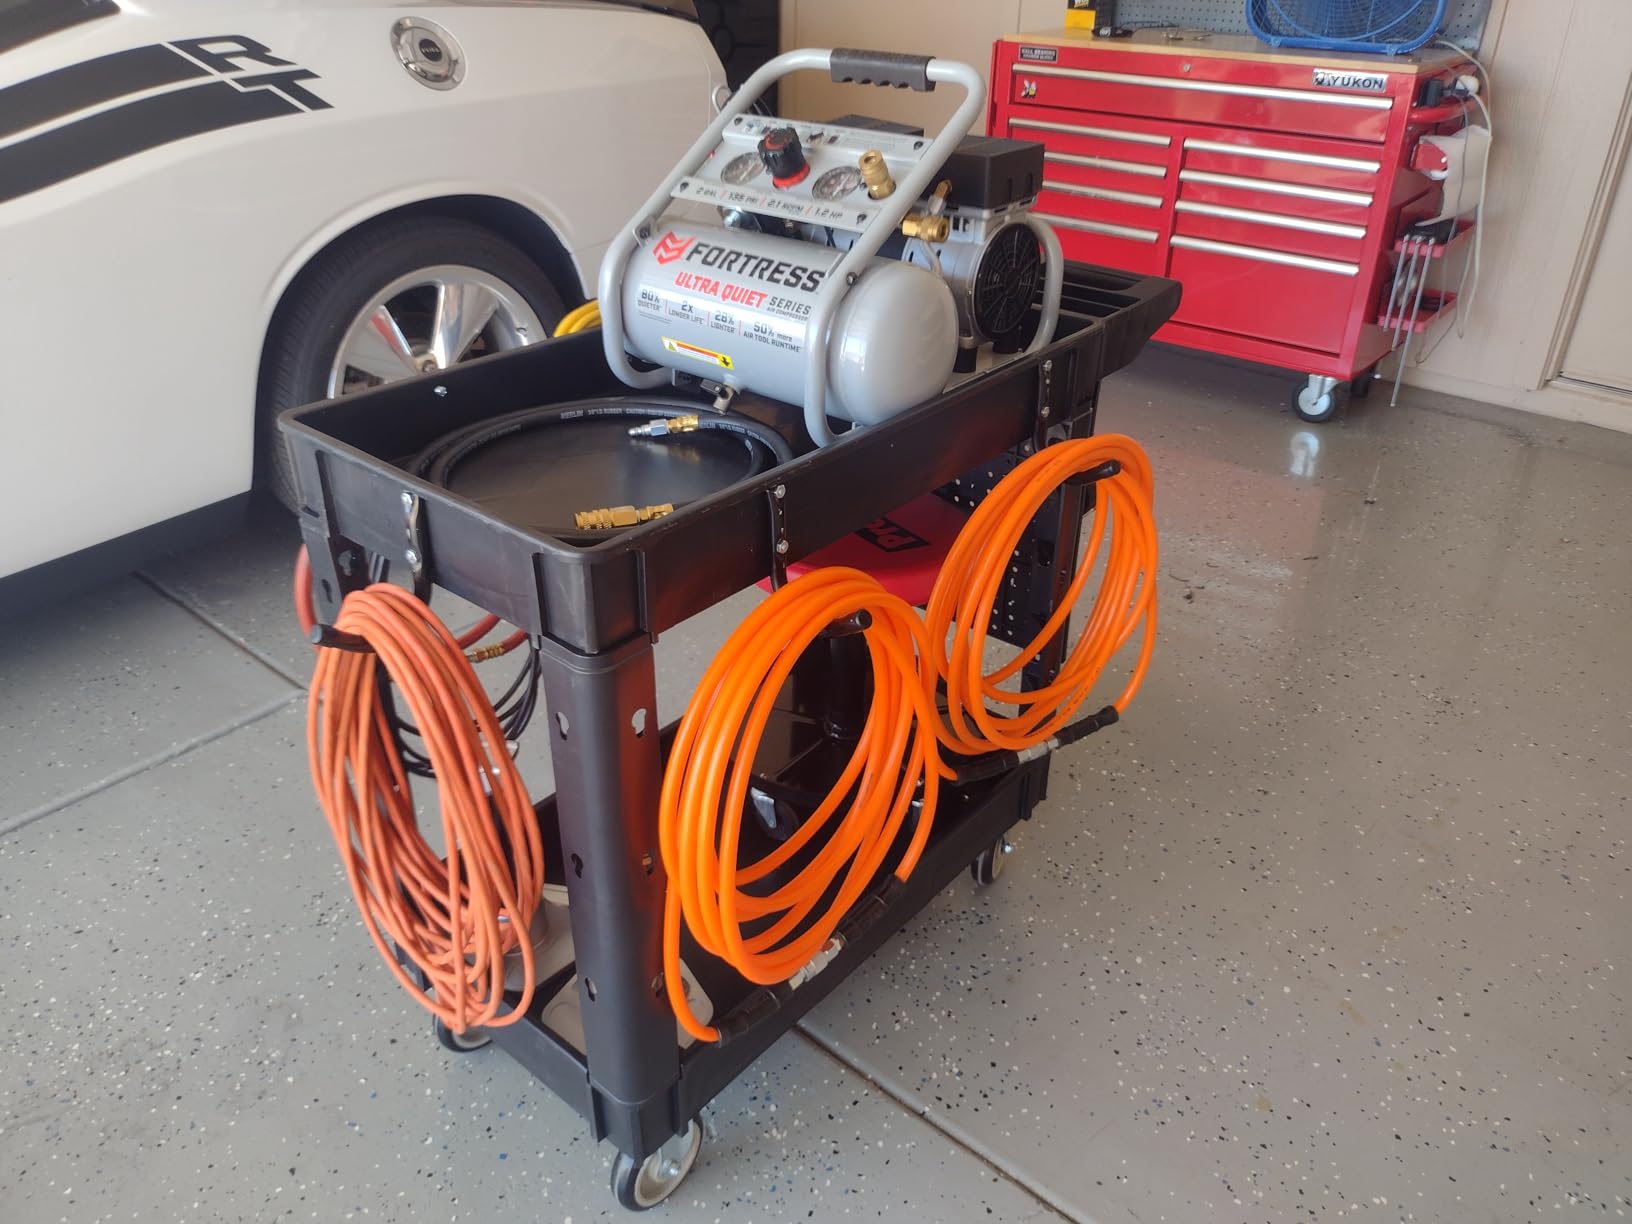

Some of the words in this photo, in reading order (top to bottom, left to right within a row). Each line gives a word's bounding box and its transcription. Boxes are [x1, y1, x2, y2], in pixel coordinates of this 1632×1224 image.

[1331, 75, 1384, 89] YUKON
[686, 242, 826, 293] FORTRESS
[674, 272, 719, 297] ULTRA
[720, 284, 768, 309] QUIET
[769, 296, 812, 315] SERIES
[668, 308, 690, 320] LONGER
[690, 314, 703, 325] LIFE
[710, 320, 735, 334] LIGHTER
[743, 330, 754, 340] AIR
[754, 334, 770, 345] TOOL
[771, 339, 802, 353] RUNTIME
[753, 321, 775, 337] 50%
[776, 333, 793, 343] more
